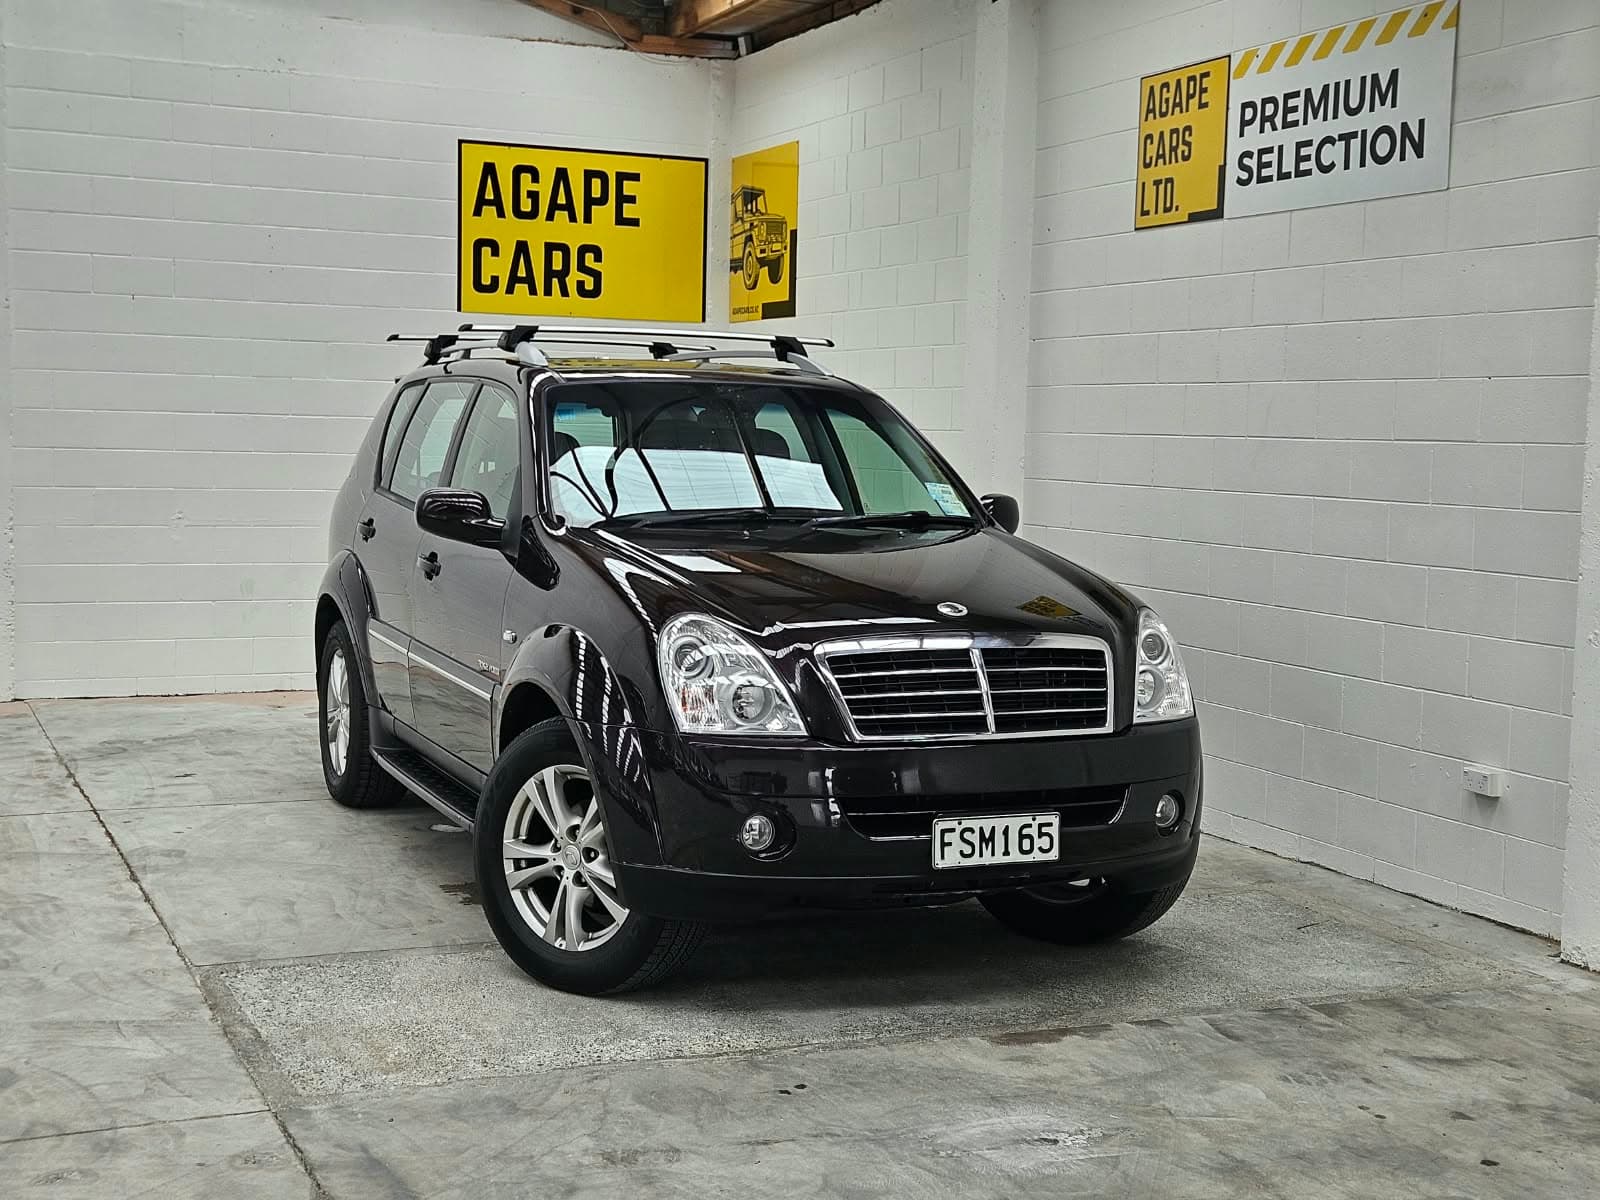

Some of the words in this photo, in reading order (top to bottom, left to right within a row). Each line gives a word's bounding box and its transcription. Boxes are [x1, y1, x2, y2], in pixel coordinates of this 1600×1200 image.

[1144, 71, 1211, 122] AGAPE
[1238, 68, 1399, 138] PREMIUM
[1142, 125, 1193, 170] CARS
[1236, 118, 1426, 187] SELECTION
[472, 161, 641, 227] AGAPE
[1140, 177, 1180, 217] LTD.
[472, 238, 603, 299] CARS
[940, 822, 1054, 860] FSM165
